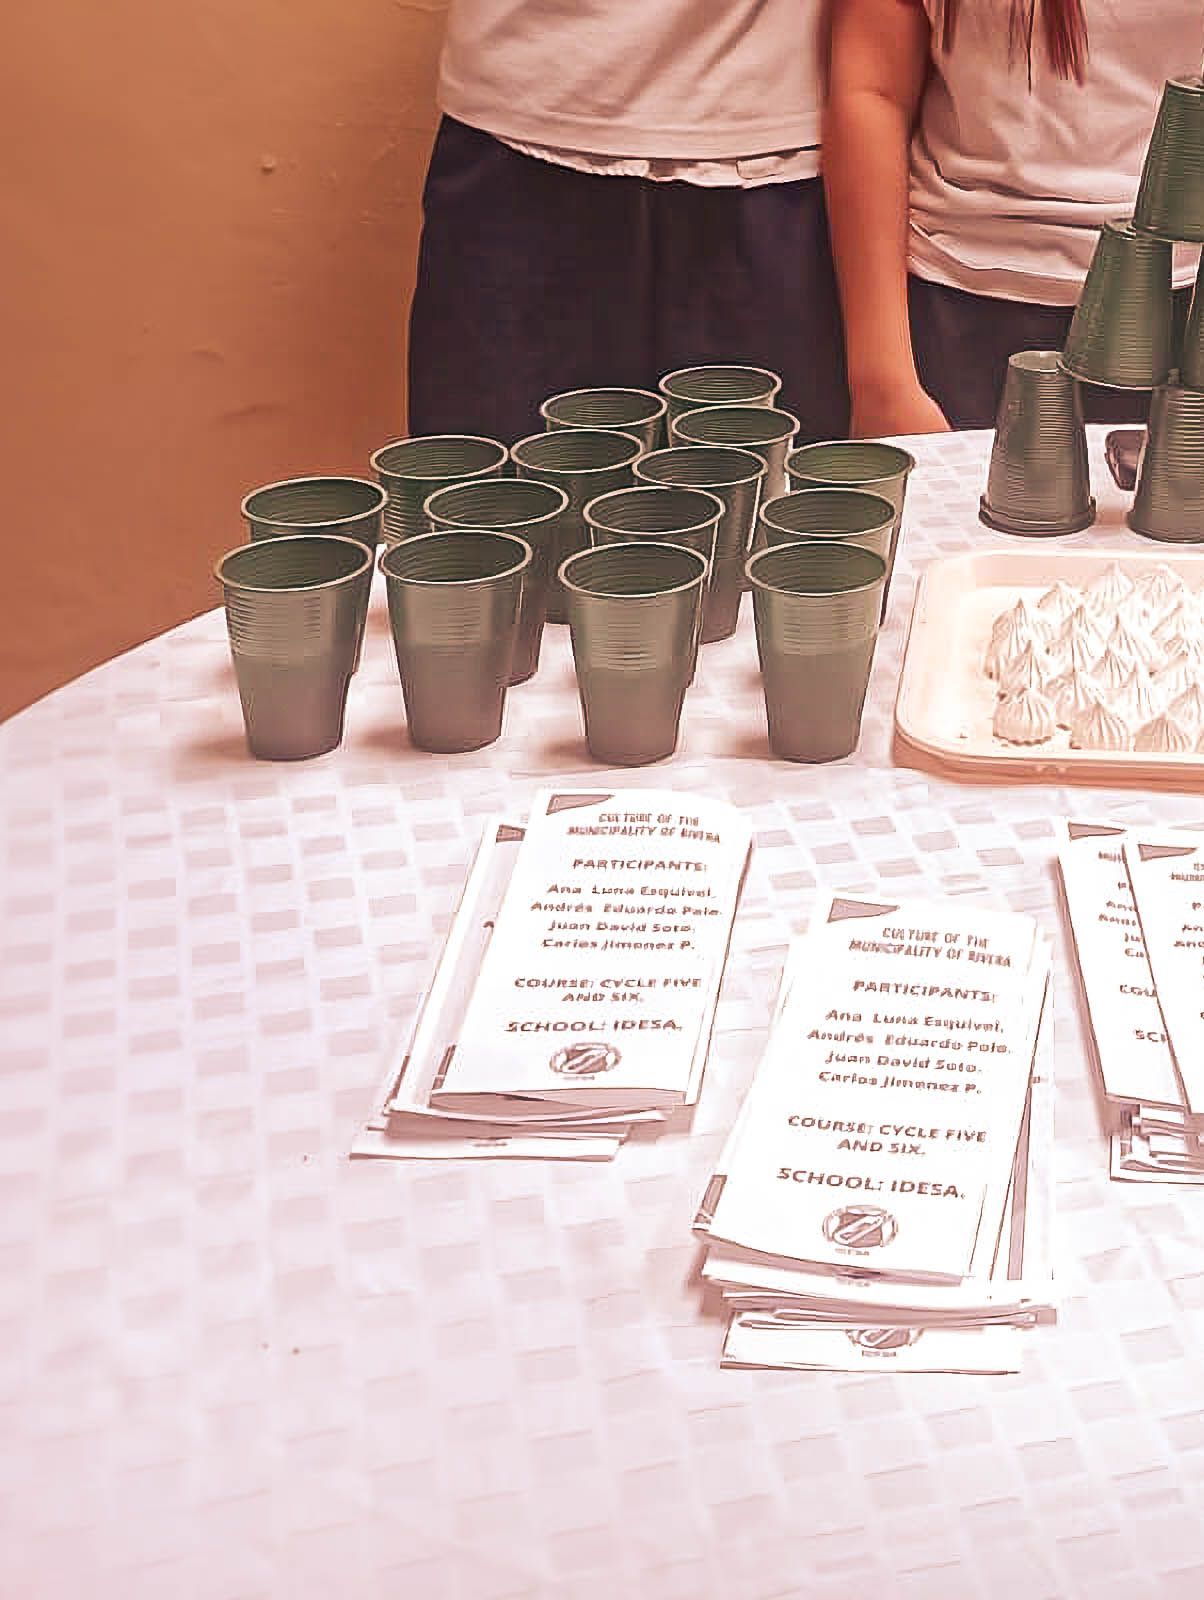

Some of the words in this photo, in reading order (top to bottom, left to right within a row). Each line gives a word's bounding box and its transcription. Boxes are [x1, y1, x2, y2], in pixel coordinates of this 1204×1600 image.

[600, 978, 656, 988] CYCLE
[663, 978, 701, 988] FIVE
[562, 992, 605, 1002] AND
[880, 1125, 941, 1139] CYCLE
[945, 1129, 987, 1142] FIVE
[837, 1138, 883, 1152] AND
